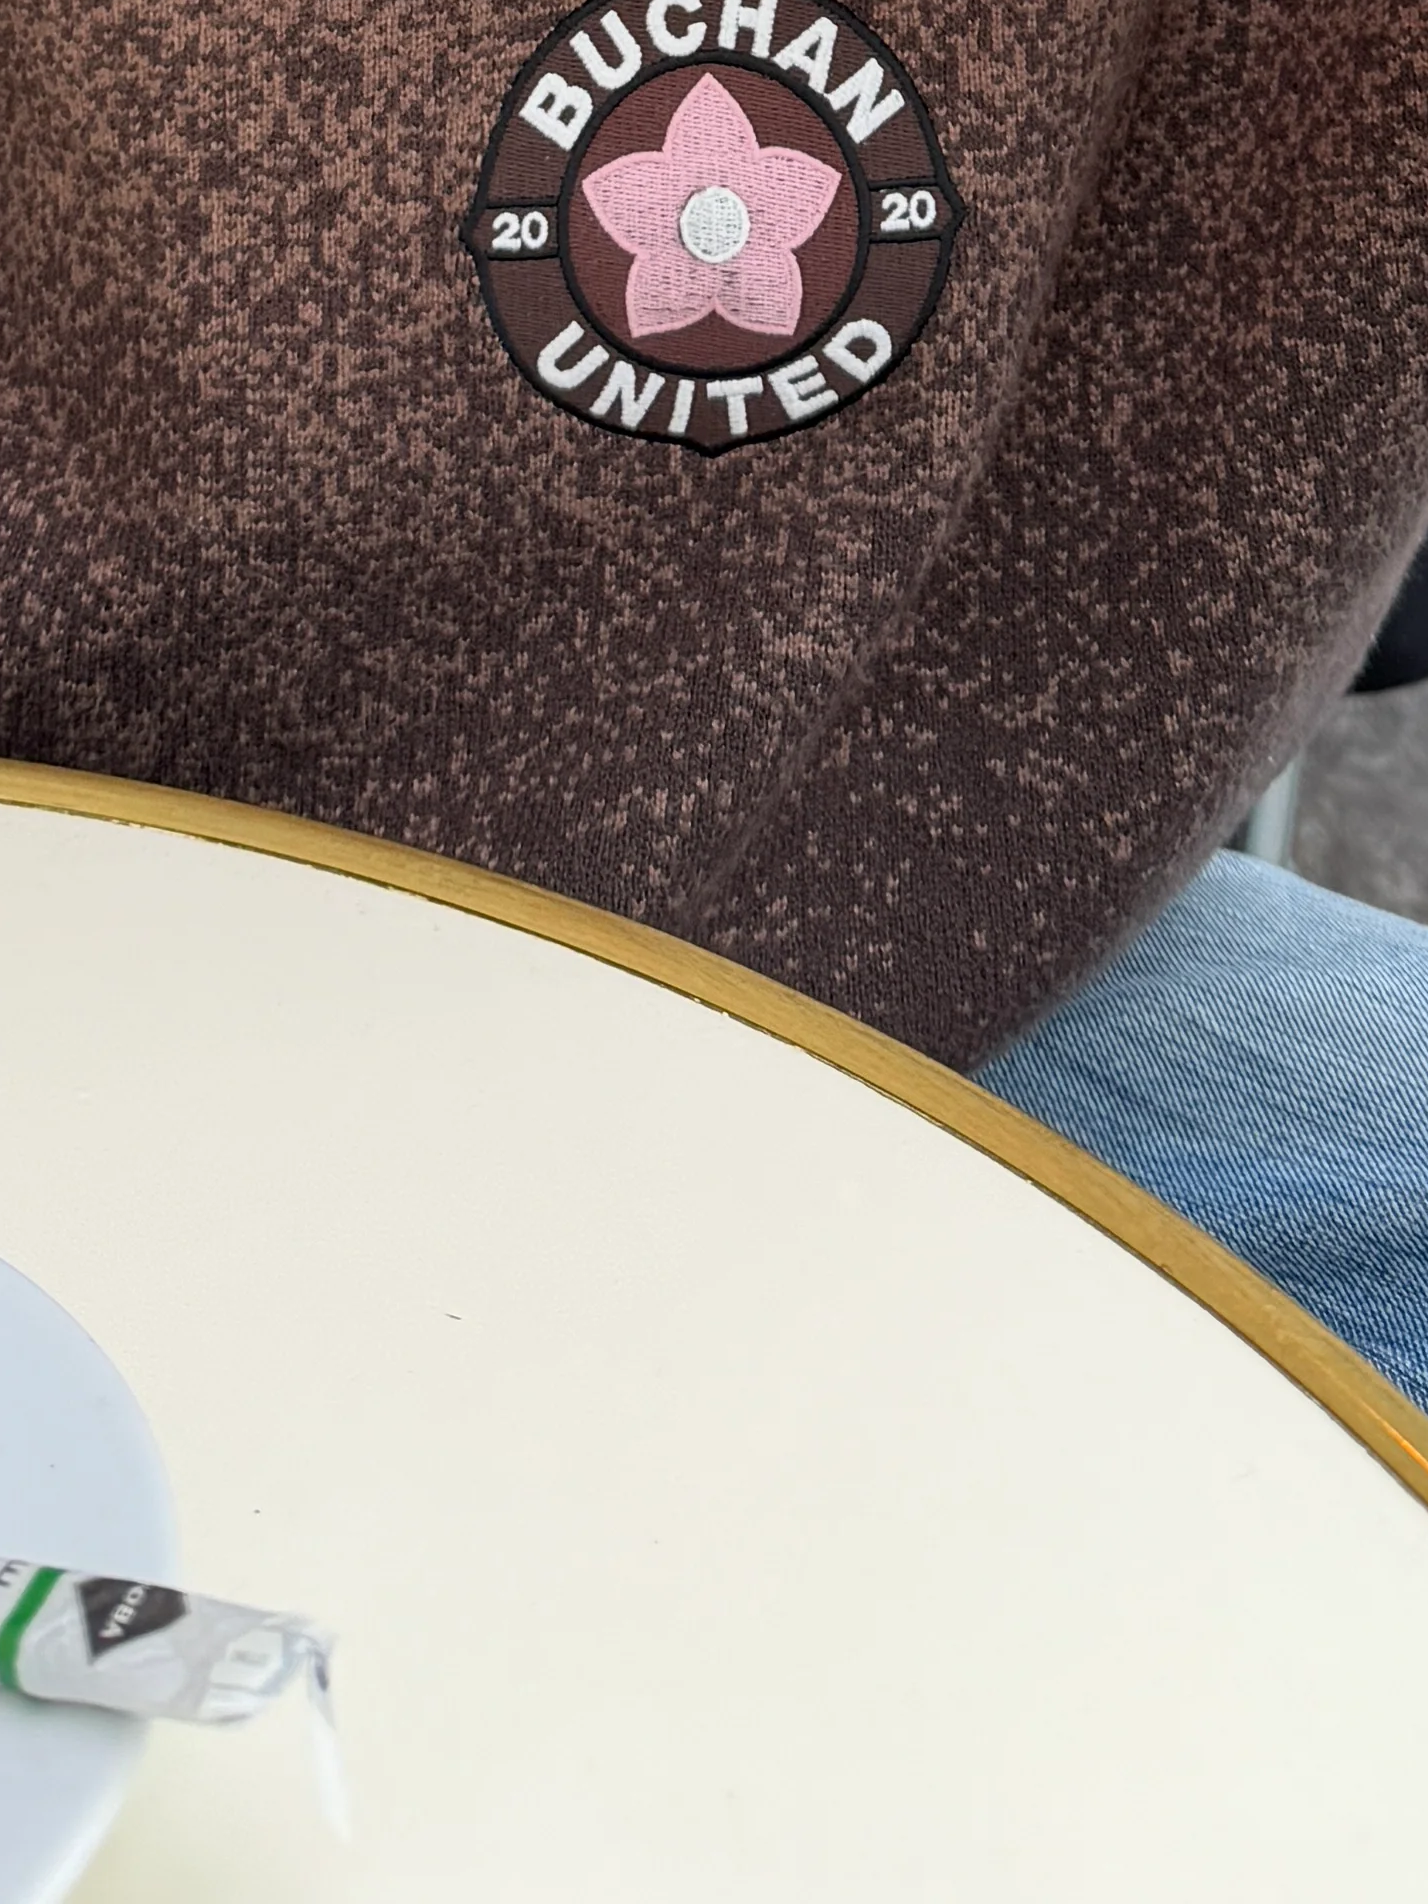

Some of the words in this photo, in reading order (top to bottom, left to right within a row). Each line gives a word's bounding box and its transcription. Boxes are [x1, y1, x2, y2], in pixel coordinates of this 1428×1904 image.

[490, 209, 550, 252] 20
[879, 189, 938, 233] 20
[536, 318, 894, 437] UNITED
